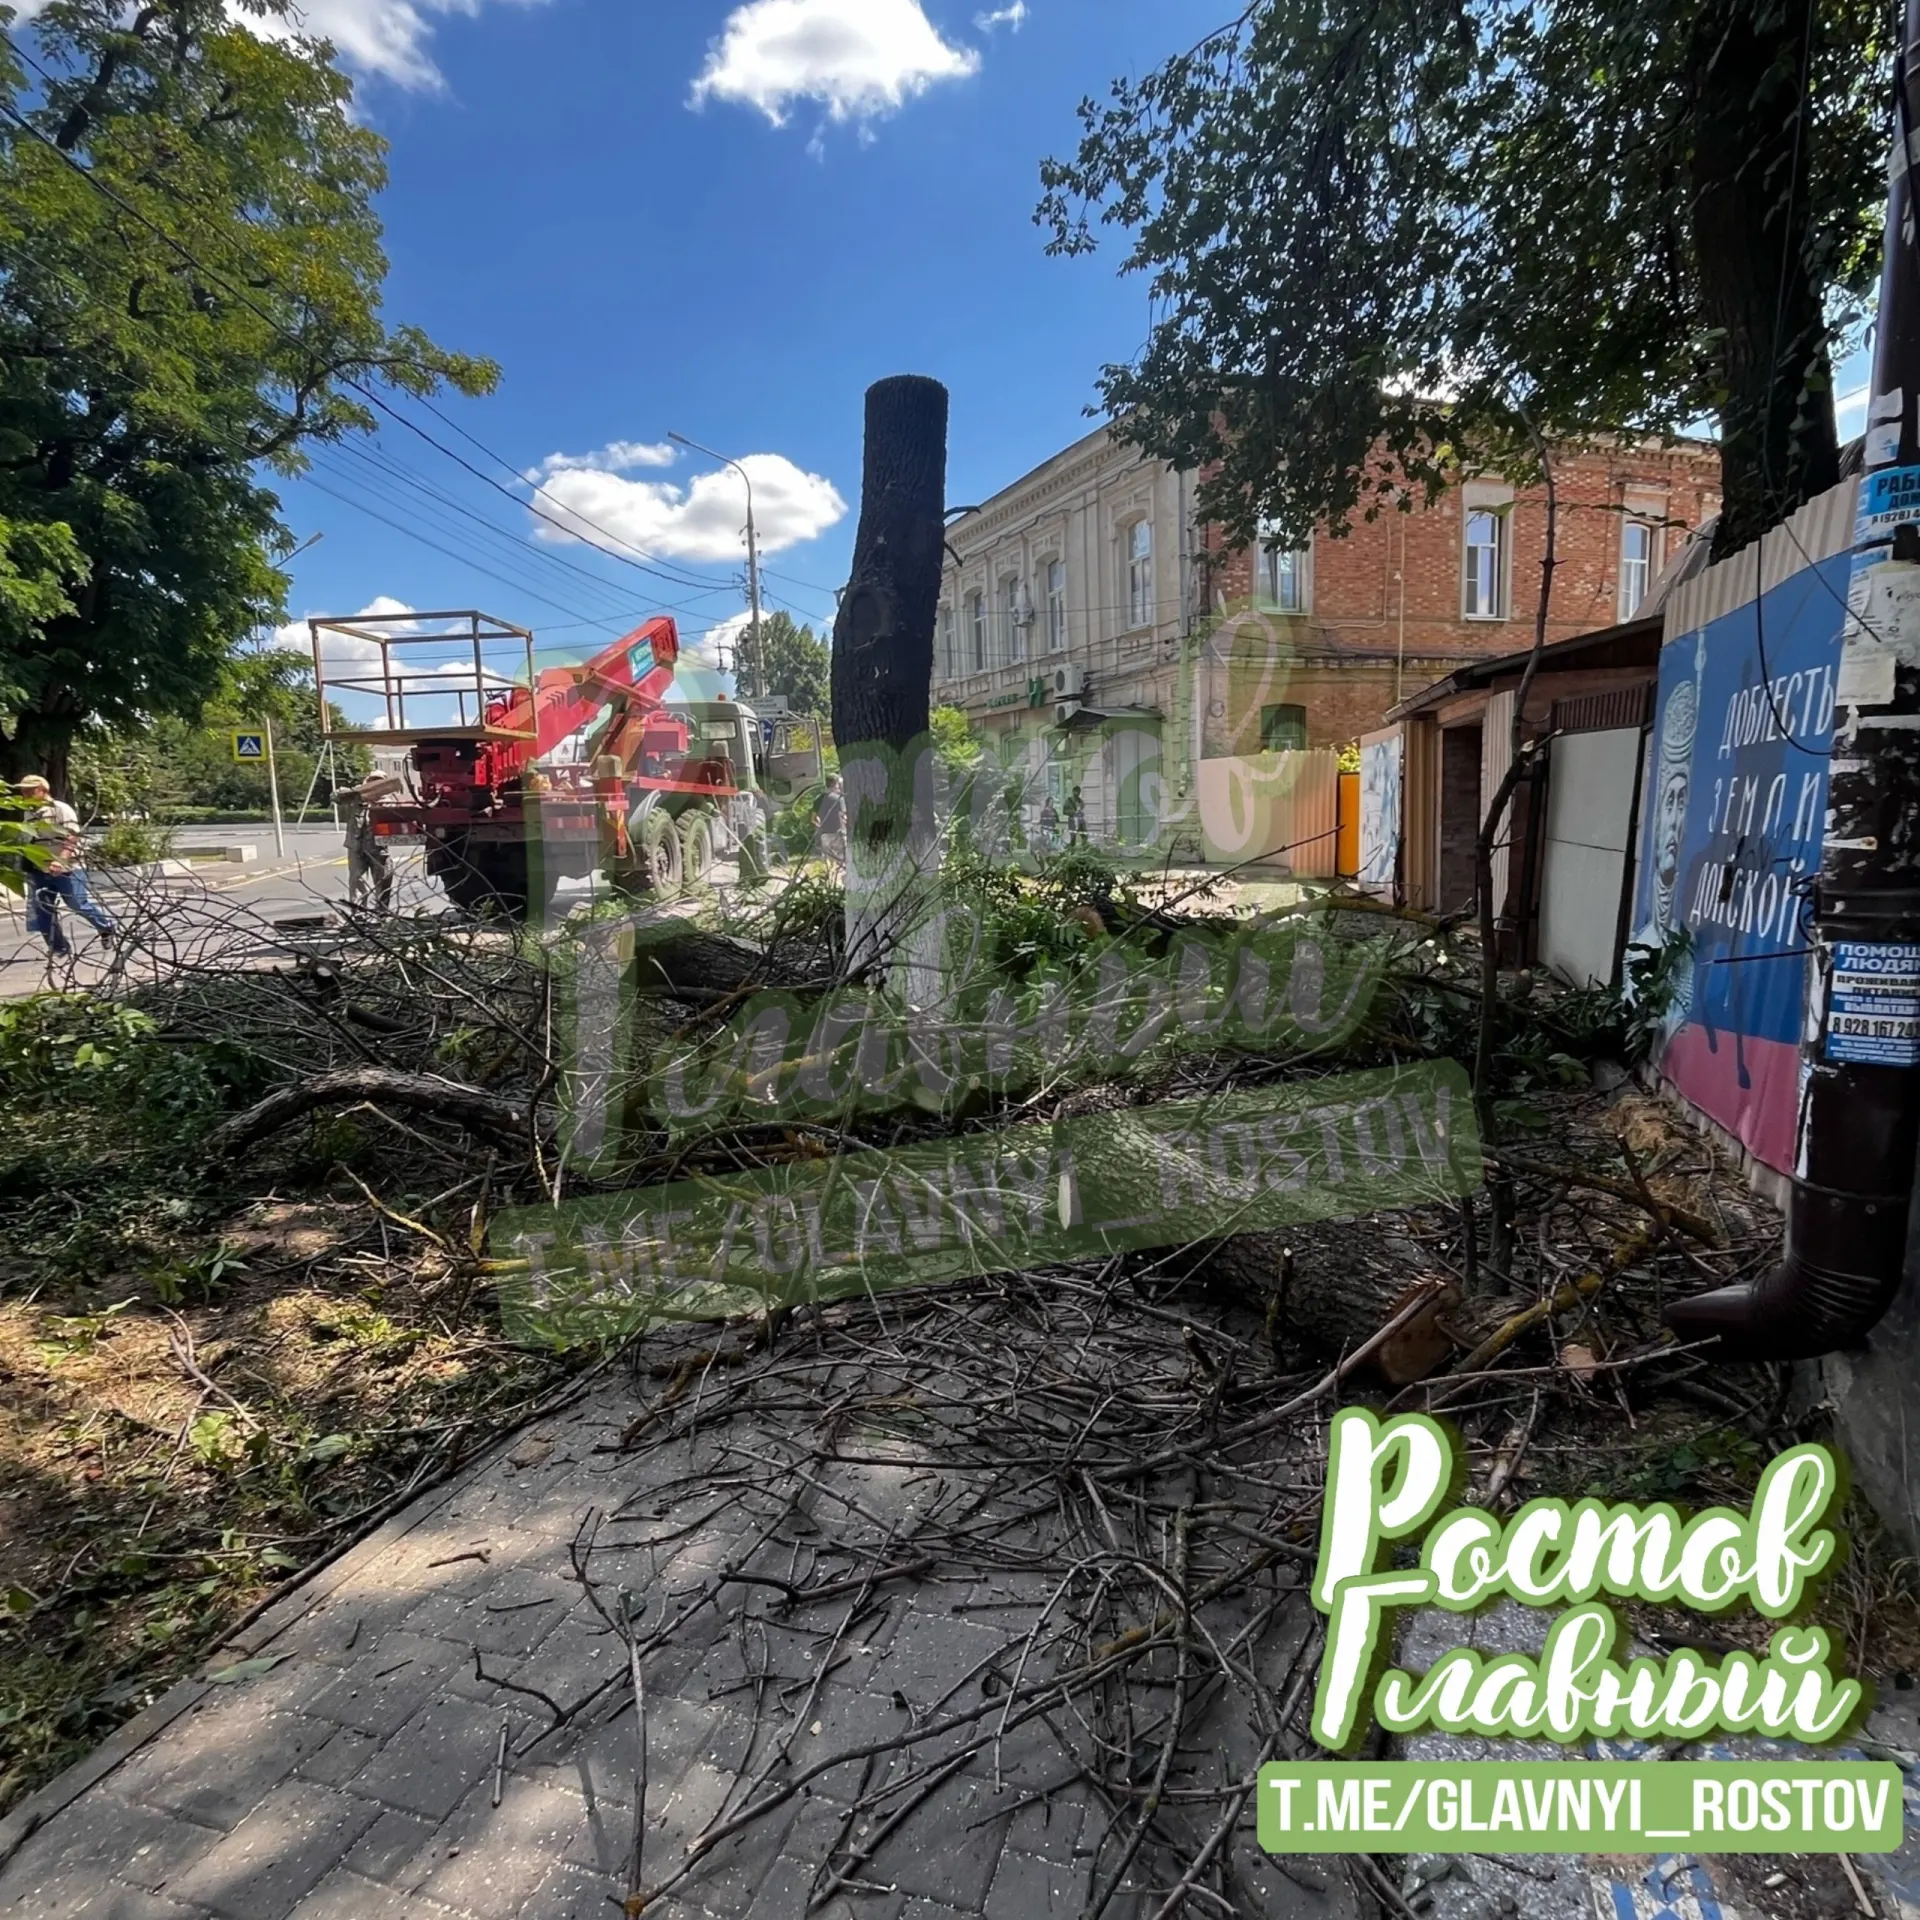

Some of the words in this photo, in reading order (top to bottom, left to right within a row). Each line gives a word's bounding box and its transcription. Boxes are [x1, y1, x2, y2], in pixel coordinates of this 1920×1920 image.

[1876, 472, 1920, 497] РАБ
[1717, 664, 1834, 760] ДОБЛЕСТЬ
[1708, 772, 1821, 842] ЗЕМЛИ
